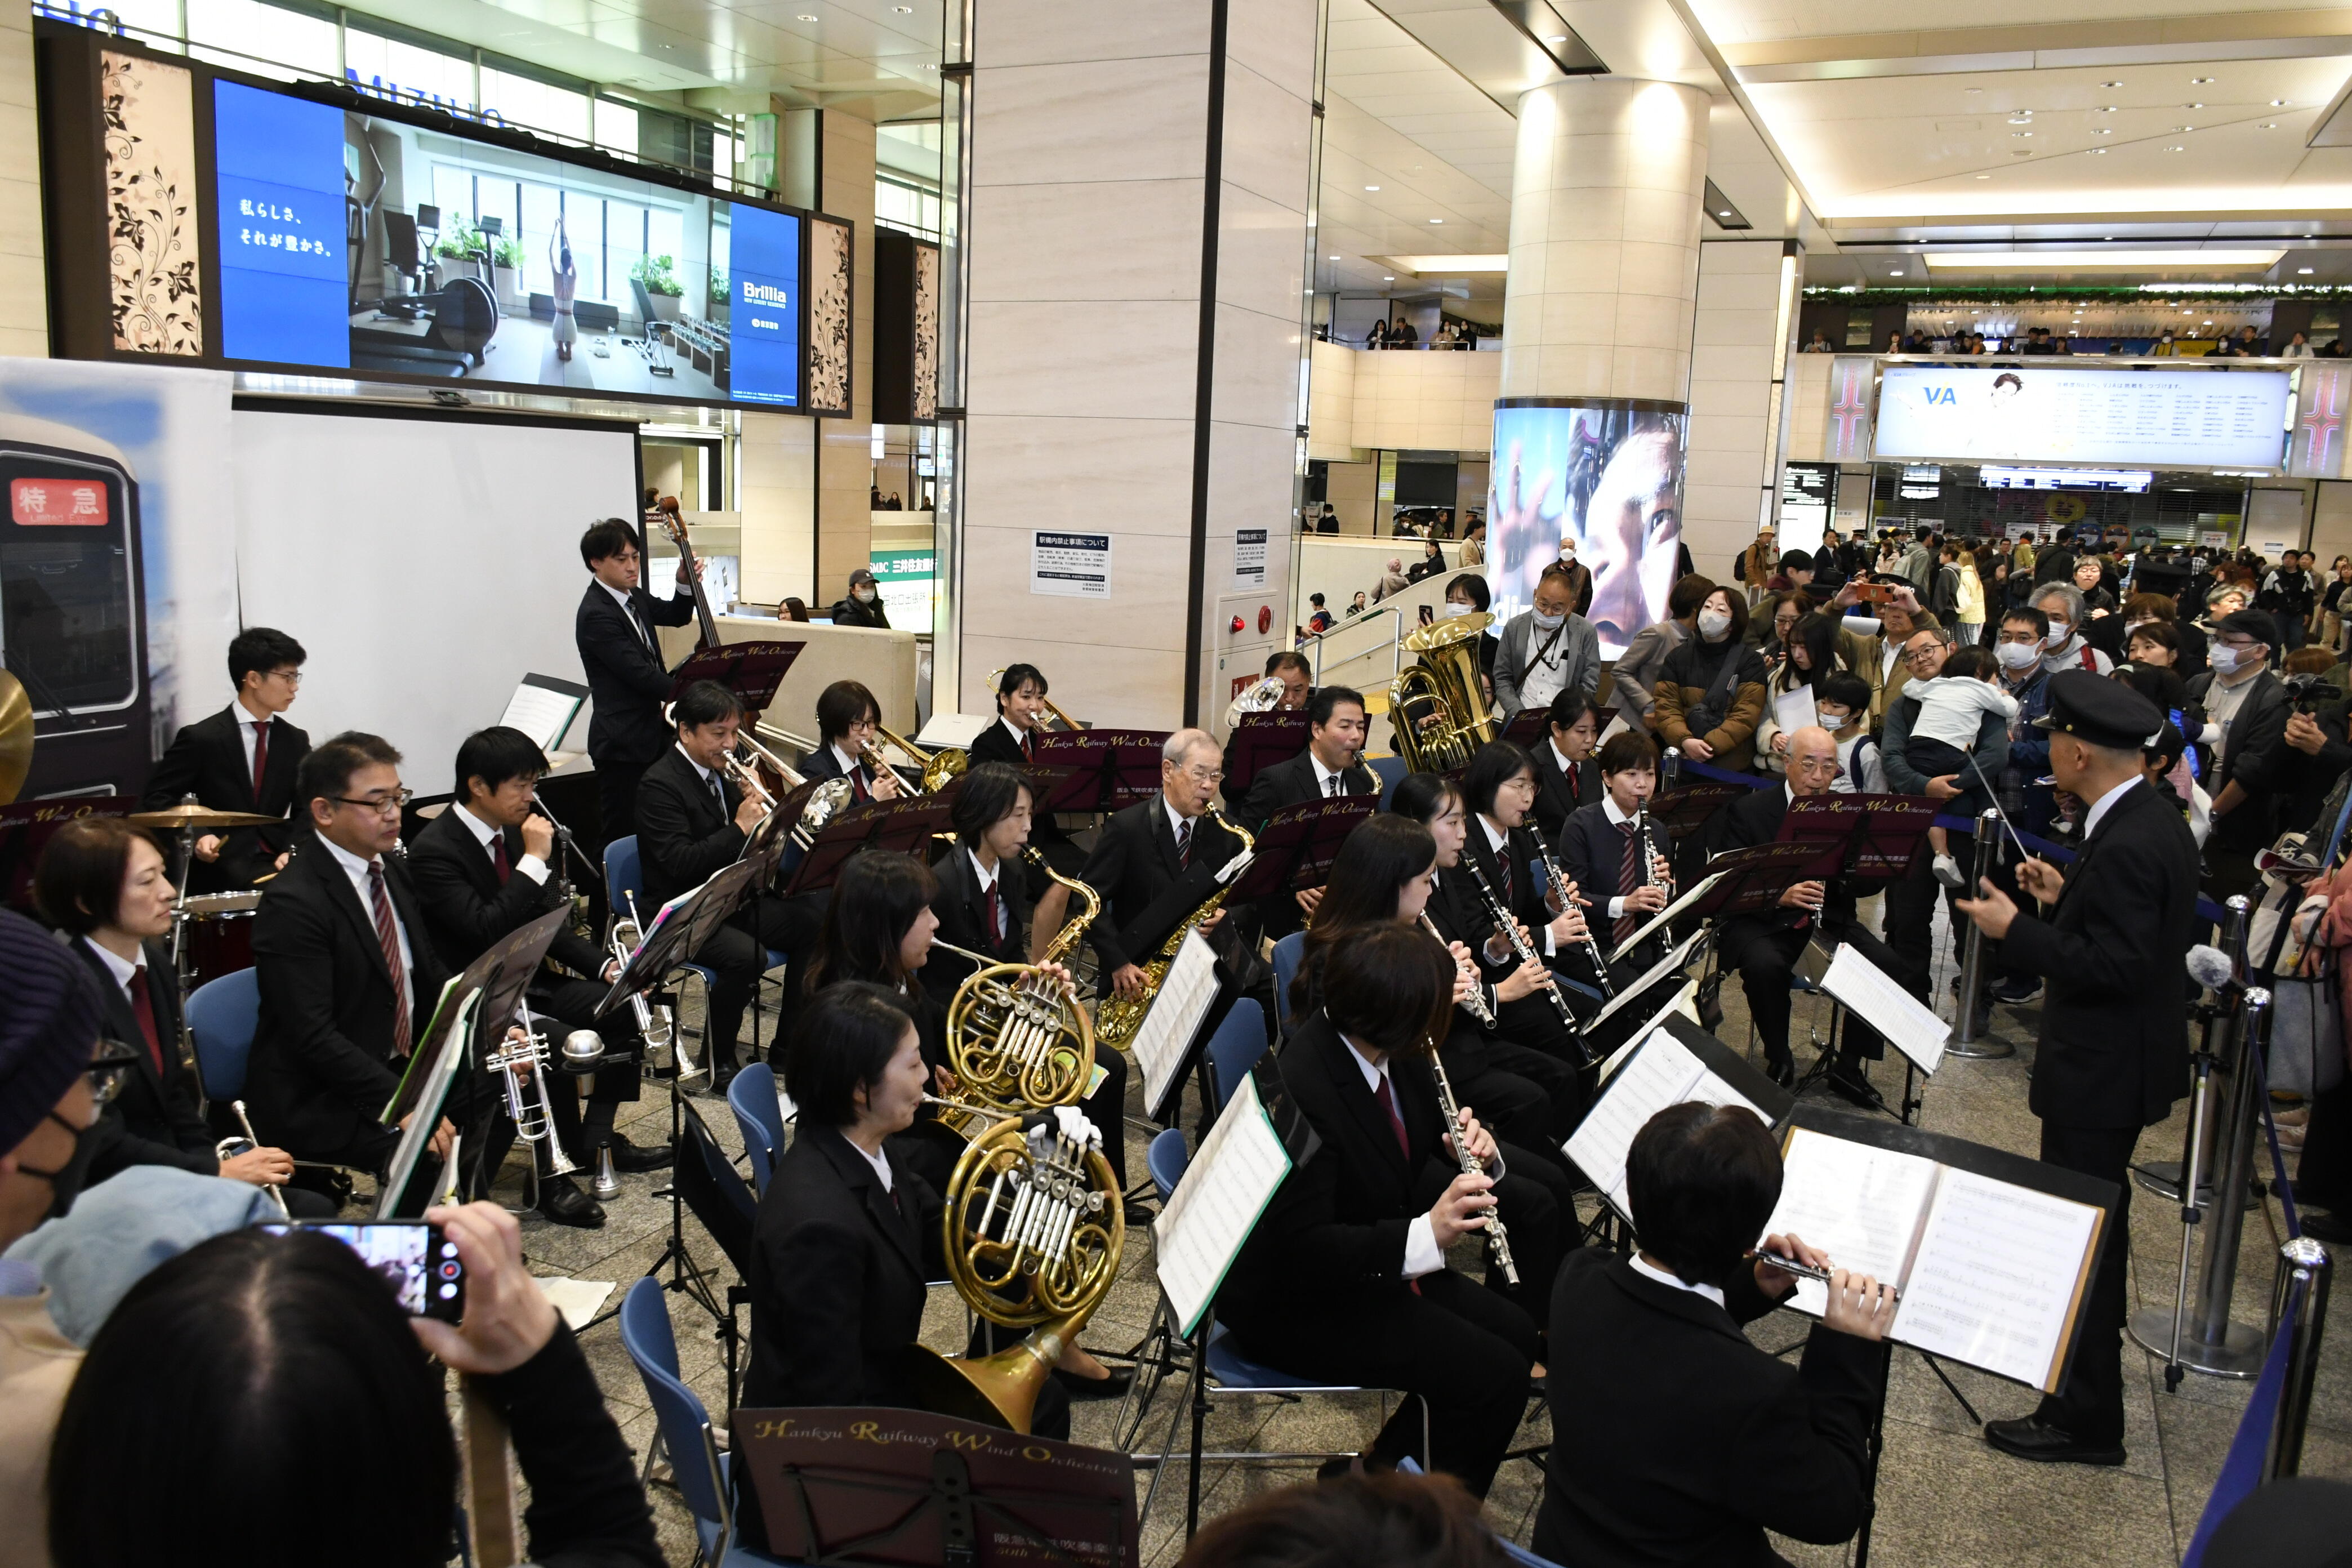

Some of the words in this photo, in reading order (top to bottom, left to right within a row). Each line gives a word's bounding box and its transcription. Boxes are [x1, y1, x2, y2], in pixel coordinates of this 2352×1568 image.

[240, 199, 301, 224] 私らしさ、
[241, 229, 331, 257] それが豊かさ。
[743, 282, 787, 303] Brillia
[19, 487, 100, 515] 特急
[1039, 536, 1105, 547] 駅構内禁止事項について
[1244, 716, 1273, 728] Hankyu
[1276, 716, 1306, 728] Railway
[1041, 737, 1073, 749] Hankyu
[1076, 736, 1108, 749] Railway
[1111, 734, 1137, 747] Wind
[1138, 737, 1164, 748] Orches
[1321, 802, 1342, 816] Wind
[1792, 800, 1826, 813] Hankyu
[1829, 800, 1862, 813] Railway
[1866, 800, 1894, 812] Wind
[1895, 801, 1933, 814] Orchestra
[755, 1419, 843, 1441] Hankyu
[850, 1420, 939, 1447] Railway
[945, 1431, 1018, 1456] Wind
[1022, 1445, 1119, 1475] Orchestra
